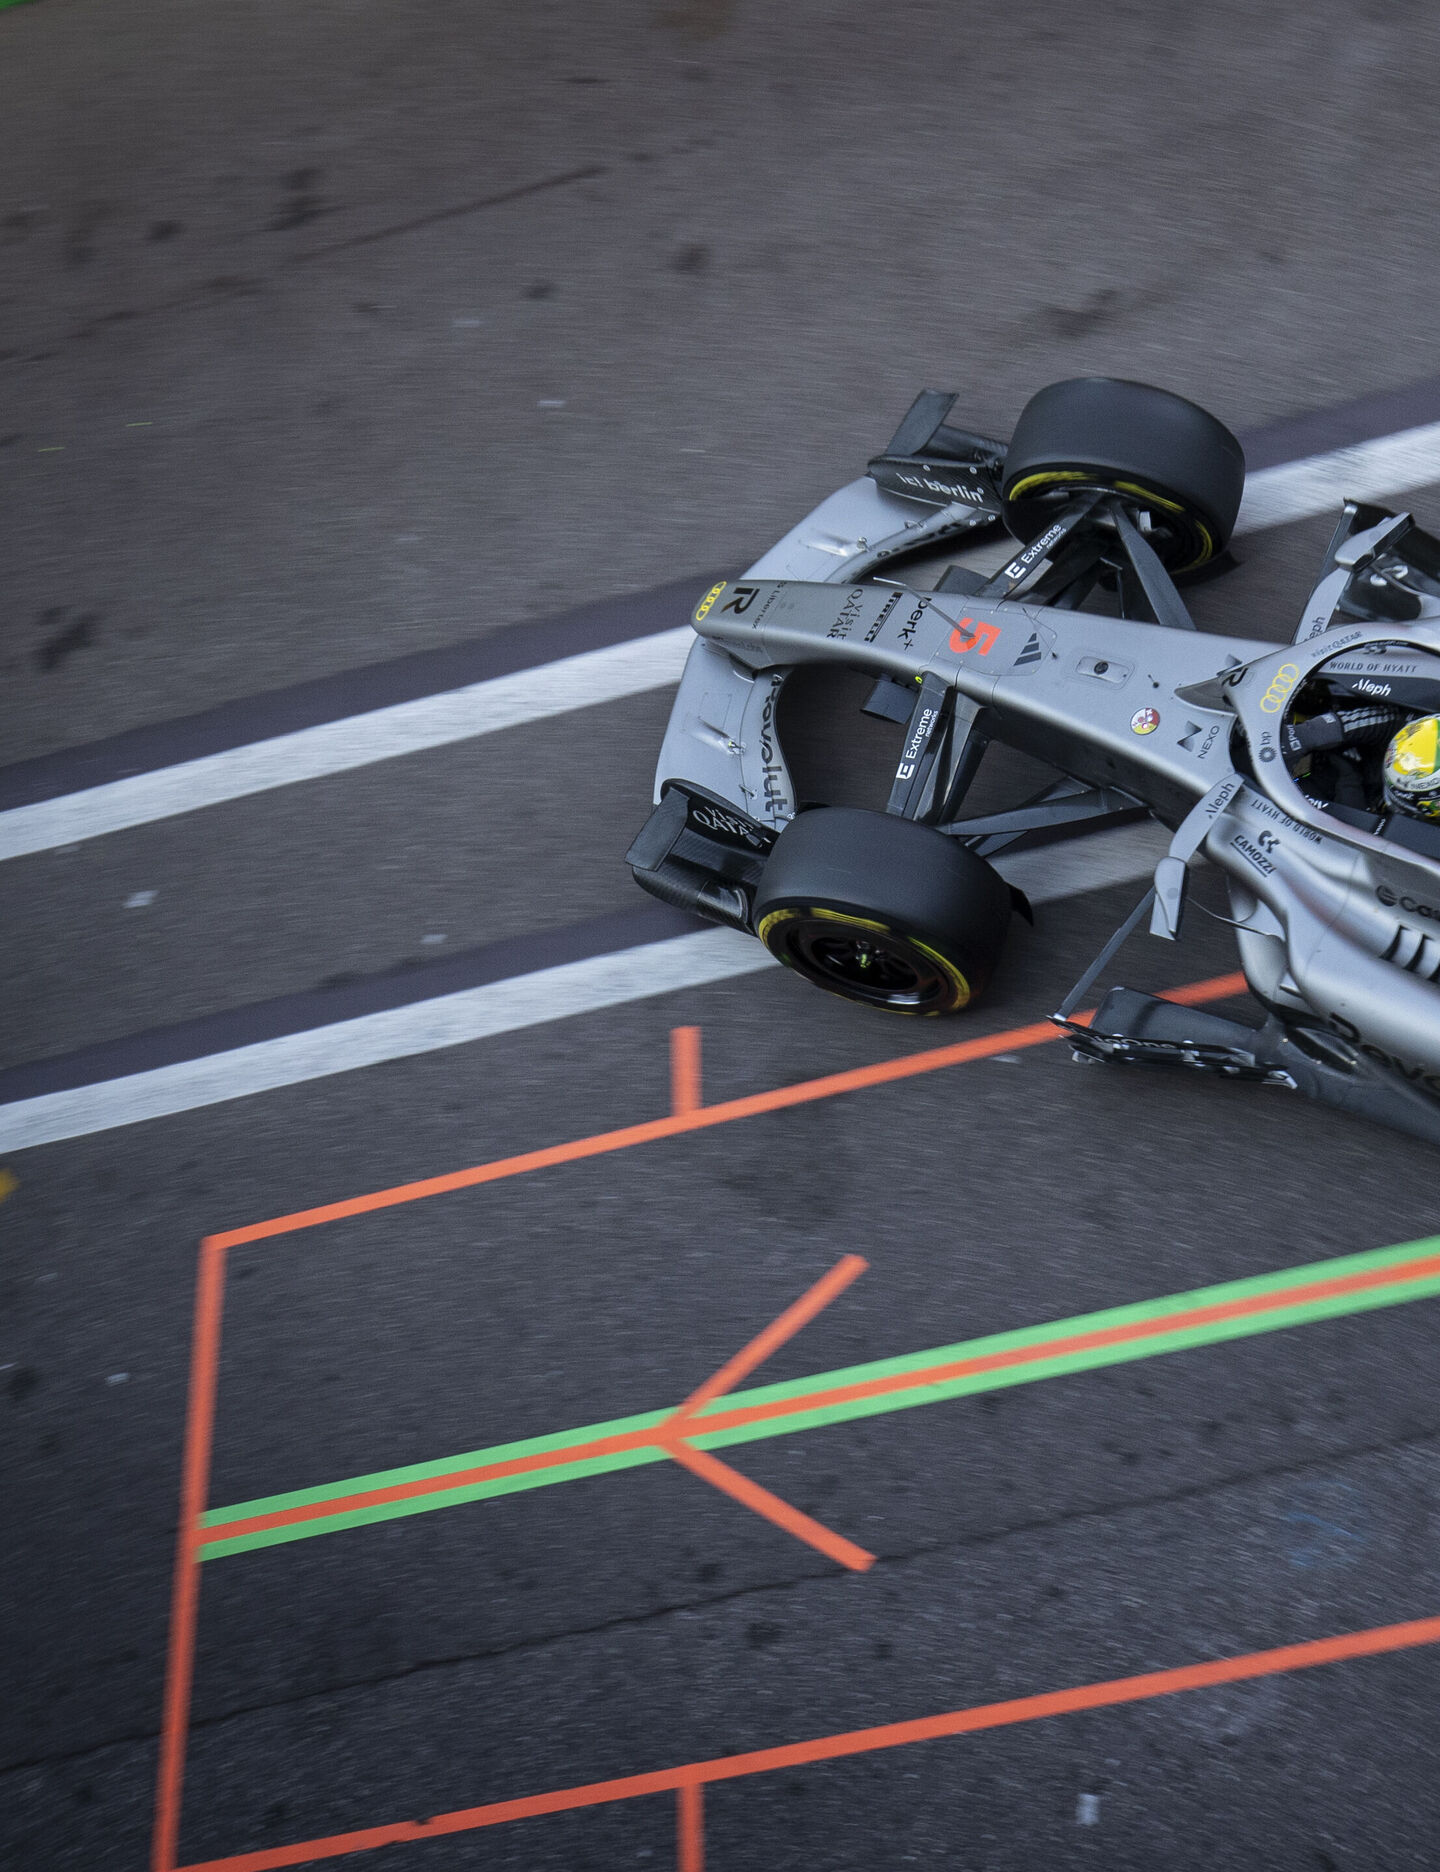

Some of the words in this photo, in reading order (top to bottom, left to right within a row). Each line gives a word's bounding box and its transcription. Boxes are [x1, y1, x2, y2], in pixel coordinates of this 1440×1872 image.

[923, 478, 984, 503] berlin
[1021, 524, 1062, 564] Extreme
[827, 588, 863, 638] QATAR
[949, 616, 1002, 656] 5
[1329, 660, 1363, 671] WORLD
[1366, 661, 1381, 672] OF
[1383, 663, 1418, 673] HYATT
[1352, 678, 1392, 697] Aleph
[905, 708, 932, 759] Extreme
[925, 710, 939, 737] networks
[1197, 725, 1220, 759] NEXO
[1205, 782, 1235, 819] Aleph
[1251, 799, 1280, 820] HYATT
[1233, 834, 1277, 875] CAMOZZI
